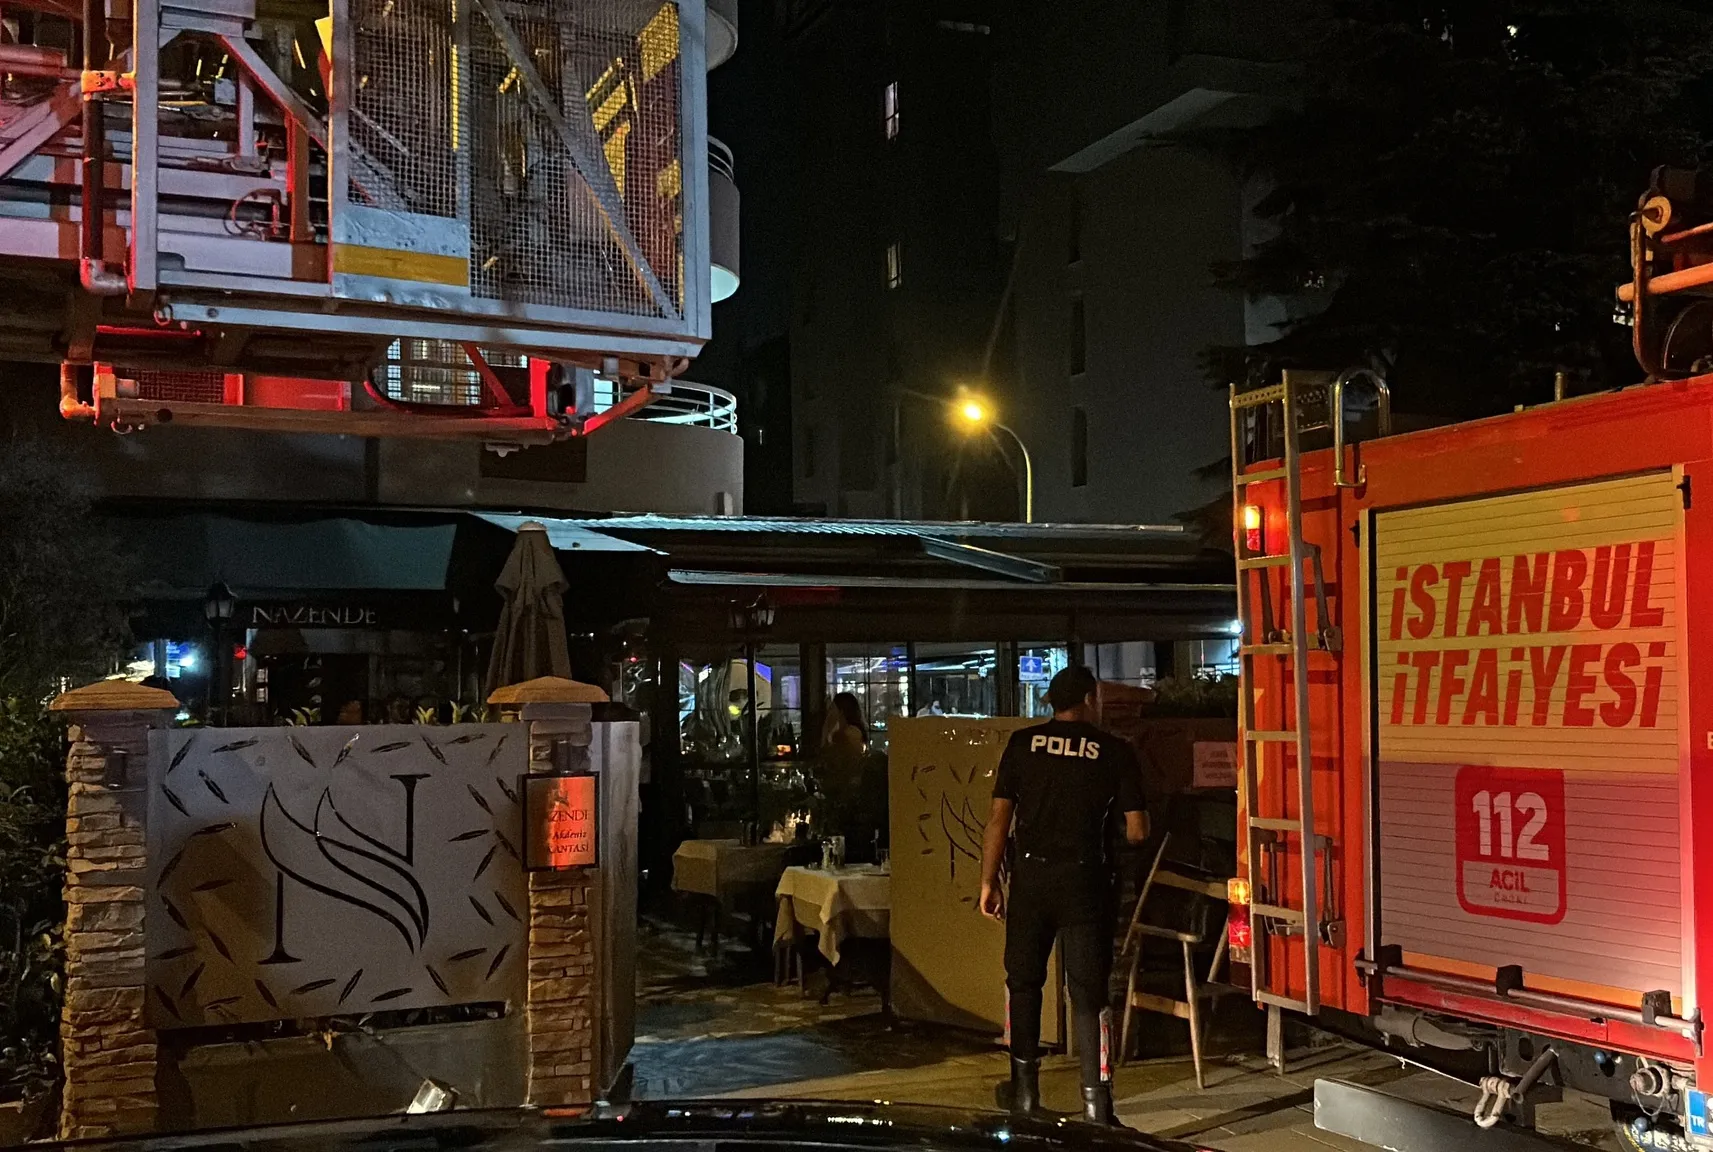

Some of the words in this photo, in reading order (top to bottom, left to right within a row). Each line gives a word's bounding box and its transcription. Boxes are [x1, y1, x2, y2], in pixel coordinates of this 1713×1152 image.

[252, 606, 377, 624] NAZENDE
[1472, 790, 1550, 861] 112
[1691, 1115, 1705, 1128] TR
